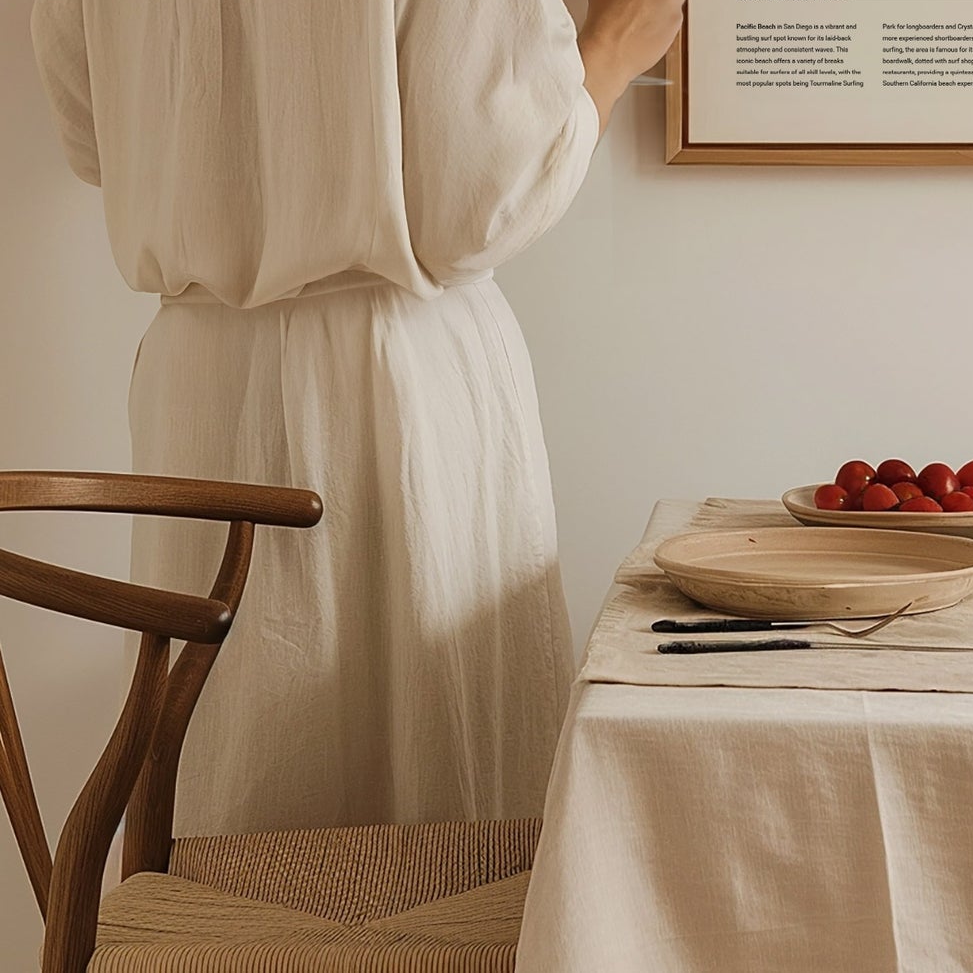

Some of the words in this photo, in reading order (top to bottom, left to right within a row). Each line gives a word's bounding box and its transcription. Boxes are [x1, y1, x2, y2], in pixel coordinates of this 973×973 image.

[796, 23, 813, 32] Diego
[736, 35, 759, 44] bustling
[773, 35, 786, 44] spot
[797, 57, 816, 66] variety
[752, 80, 774, 89] popular
[775, 80, 791, 89] spots
[793, 80, 809, 89] being
[843, 80, 864, 89] Surfing
